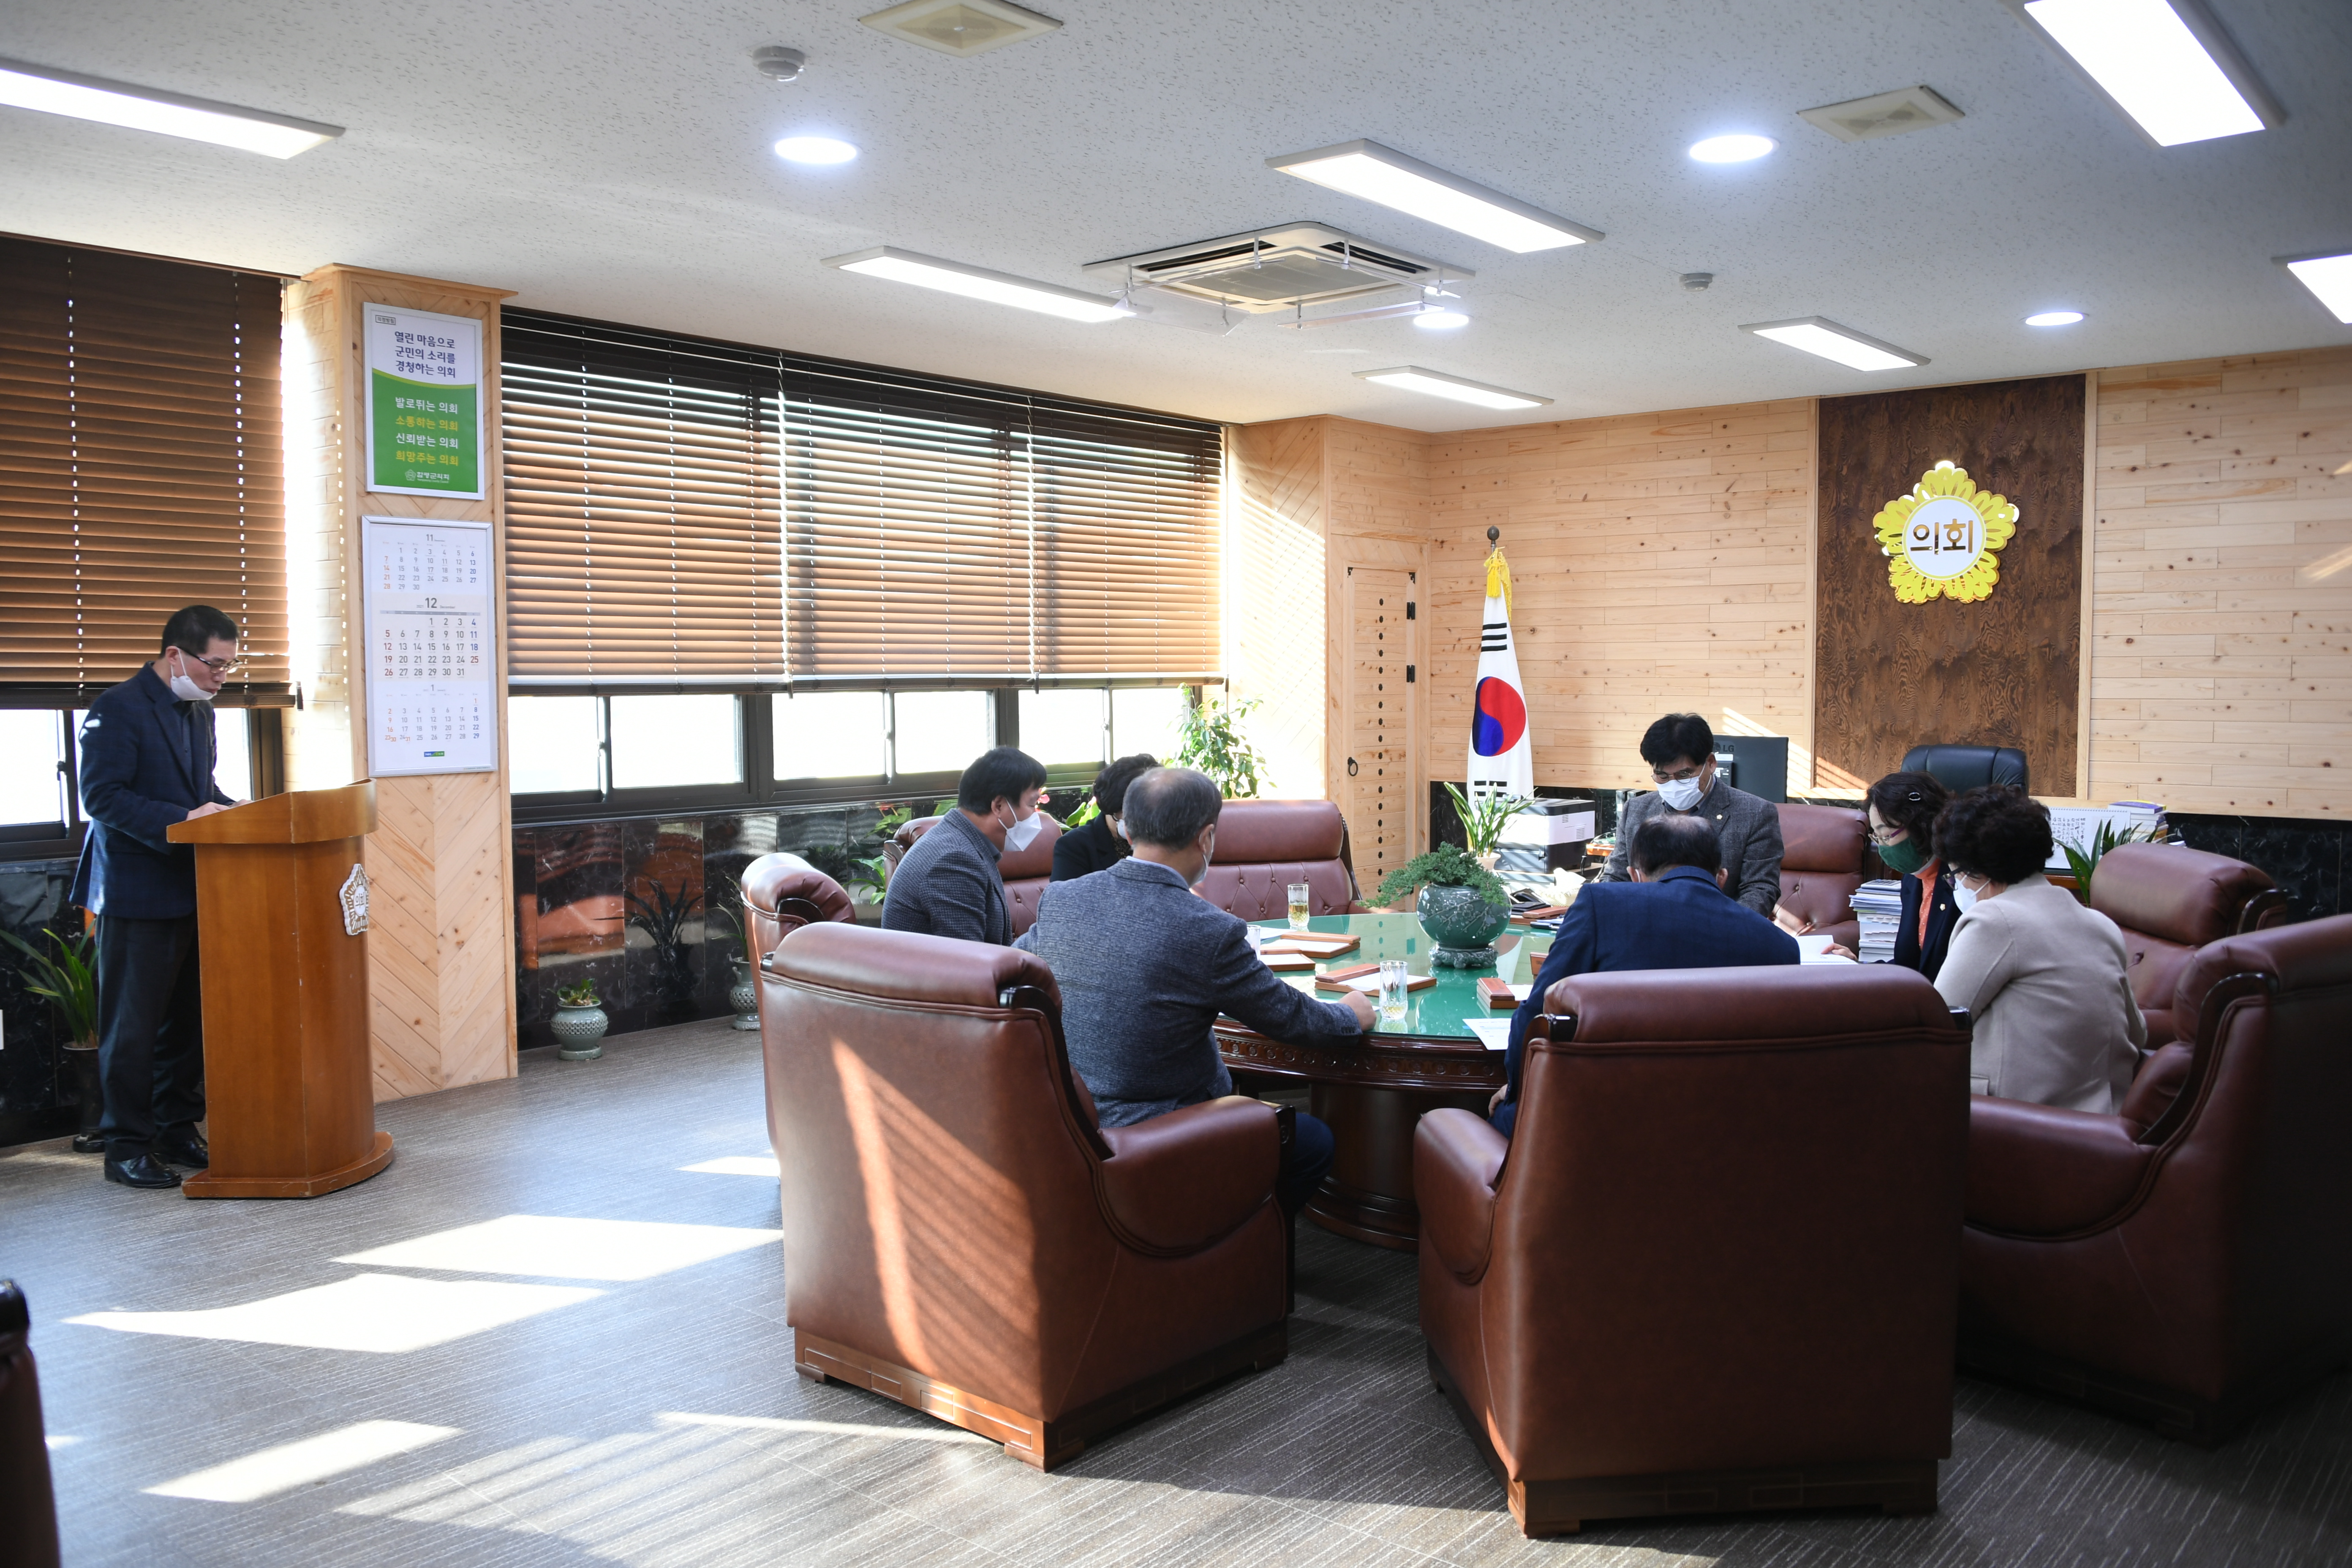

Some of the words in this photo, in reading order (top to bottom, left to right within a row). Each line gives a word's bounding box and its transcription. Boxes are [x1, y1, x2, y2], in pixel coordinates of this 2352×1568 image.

[395, 331, 414, 343] 열린
[417, 335, 455, 348] 마음으로
[395, 346, 424, 359] 군민의
[427, 351, 455, 364] 소리를
[395, 360, 433, 375] 경청하는
[437, 365, 455, 378] 의회
[395, 397, 435, 412] 발로뛰는
[439, 403, 457, 414] 의회
[395, 415, 436, 430] 소통하는
[439, 420, 457, 431] 의회
[396, 433, 436, 448] 신뢰받는
[439, 437, 458, 449] 의회
[396, 451, 436, 465] 희망주는
[439, 455, 458, 466] 의회
[417, 472, 449, 480] 함평군의회
[1910, 518, 1973, 555] 의회
[425, 598, 437, 608] 12
[355, 892, 365, 908] 의회
